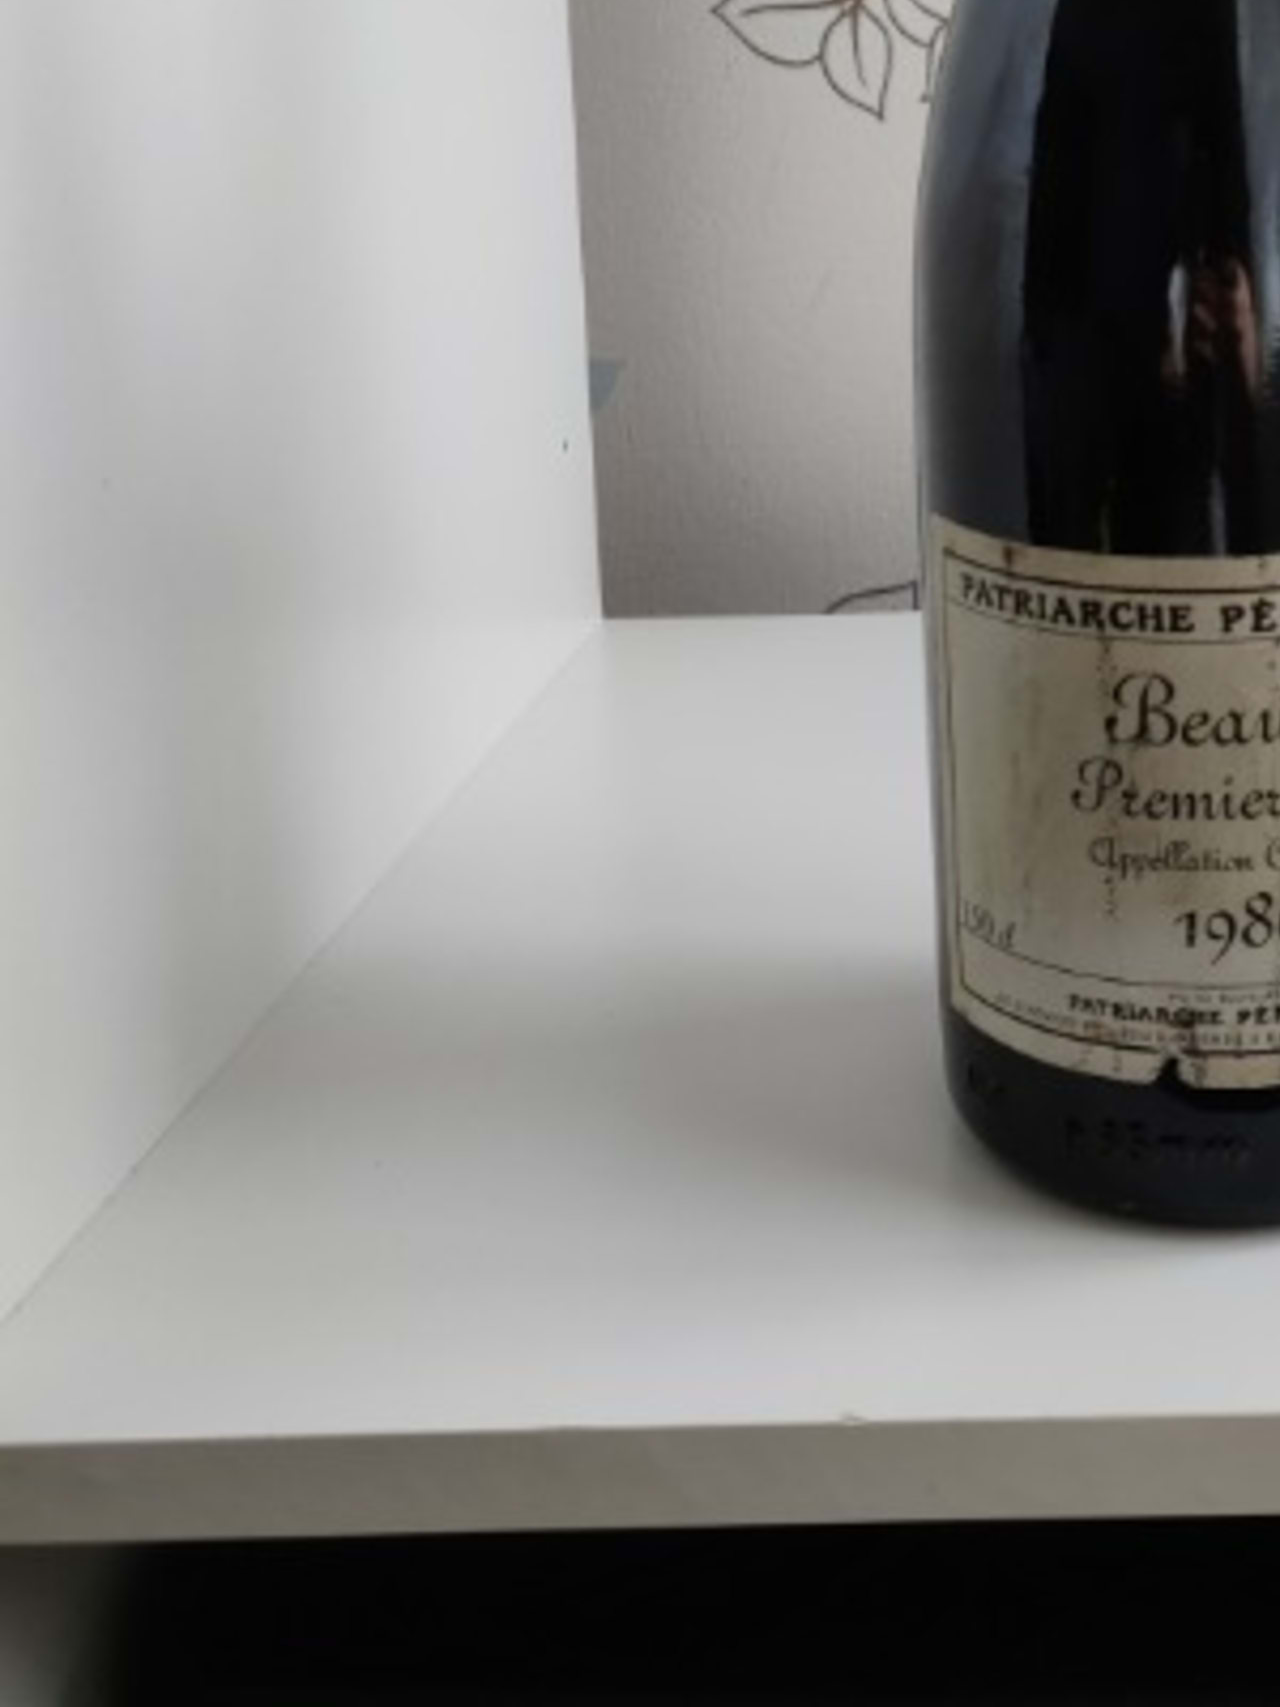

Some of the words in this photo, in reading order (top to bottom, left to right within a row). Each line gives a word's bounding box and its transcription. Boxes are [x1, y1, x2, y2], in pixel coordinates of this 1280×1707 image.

[960, 570, 1194, 633] PATRIARCHE
[1089, 837, 1255, 880] Appellation
[1069, 993, 1222, 1027] PATRIARCHE
